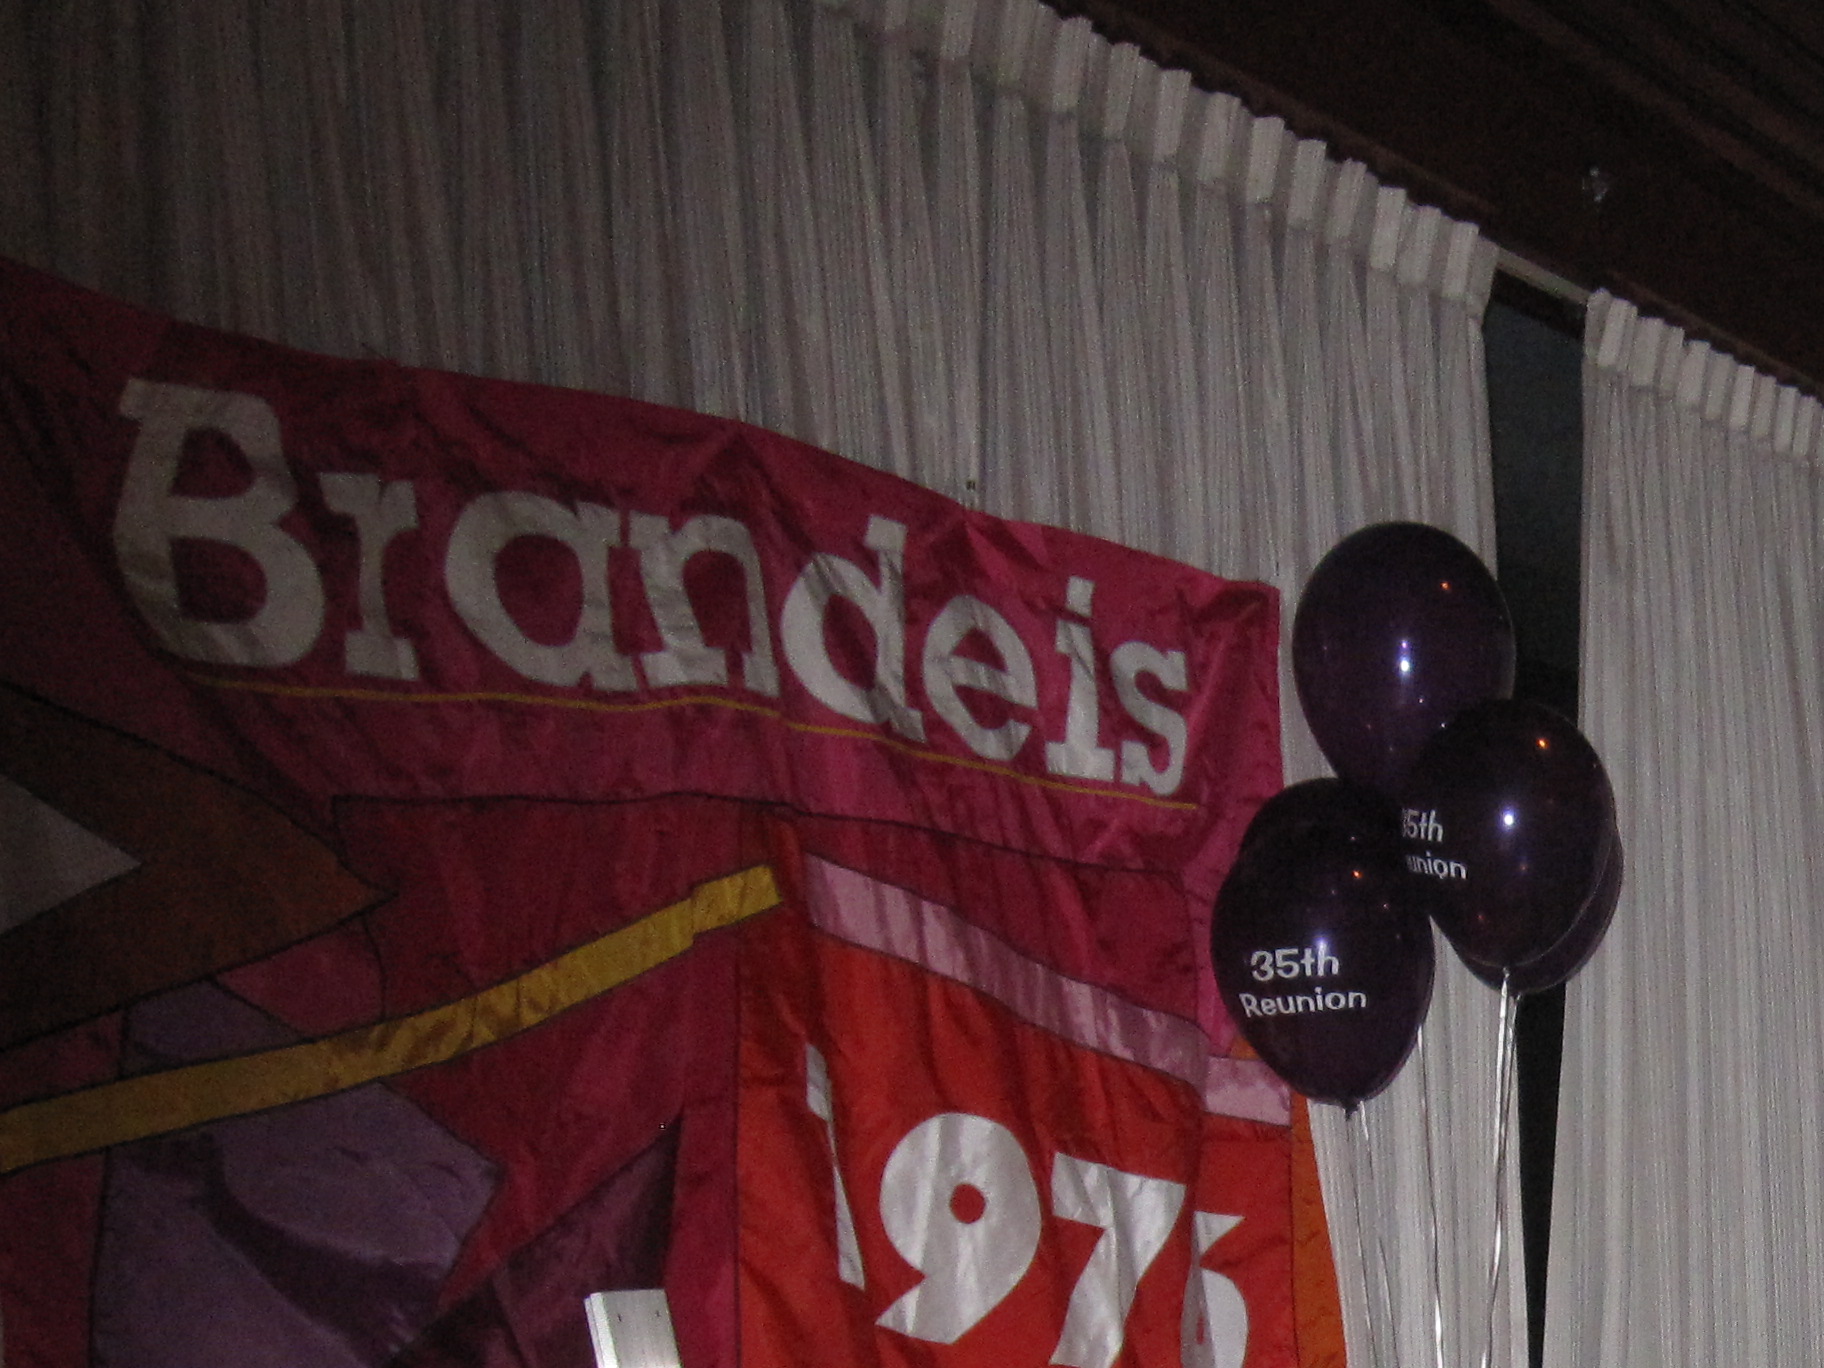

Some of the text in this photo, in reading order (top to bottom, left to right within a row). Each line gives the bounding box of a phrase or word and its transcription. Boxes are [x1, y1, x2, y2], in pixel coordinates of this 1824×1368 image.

[113, 378, 1188, 796] Brandeis
[1406, 850, 1467, 879] union
[1251, 944, 1340, 981] 35th
[1239, 987, 1367, 1018] Reunion
